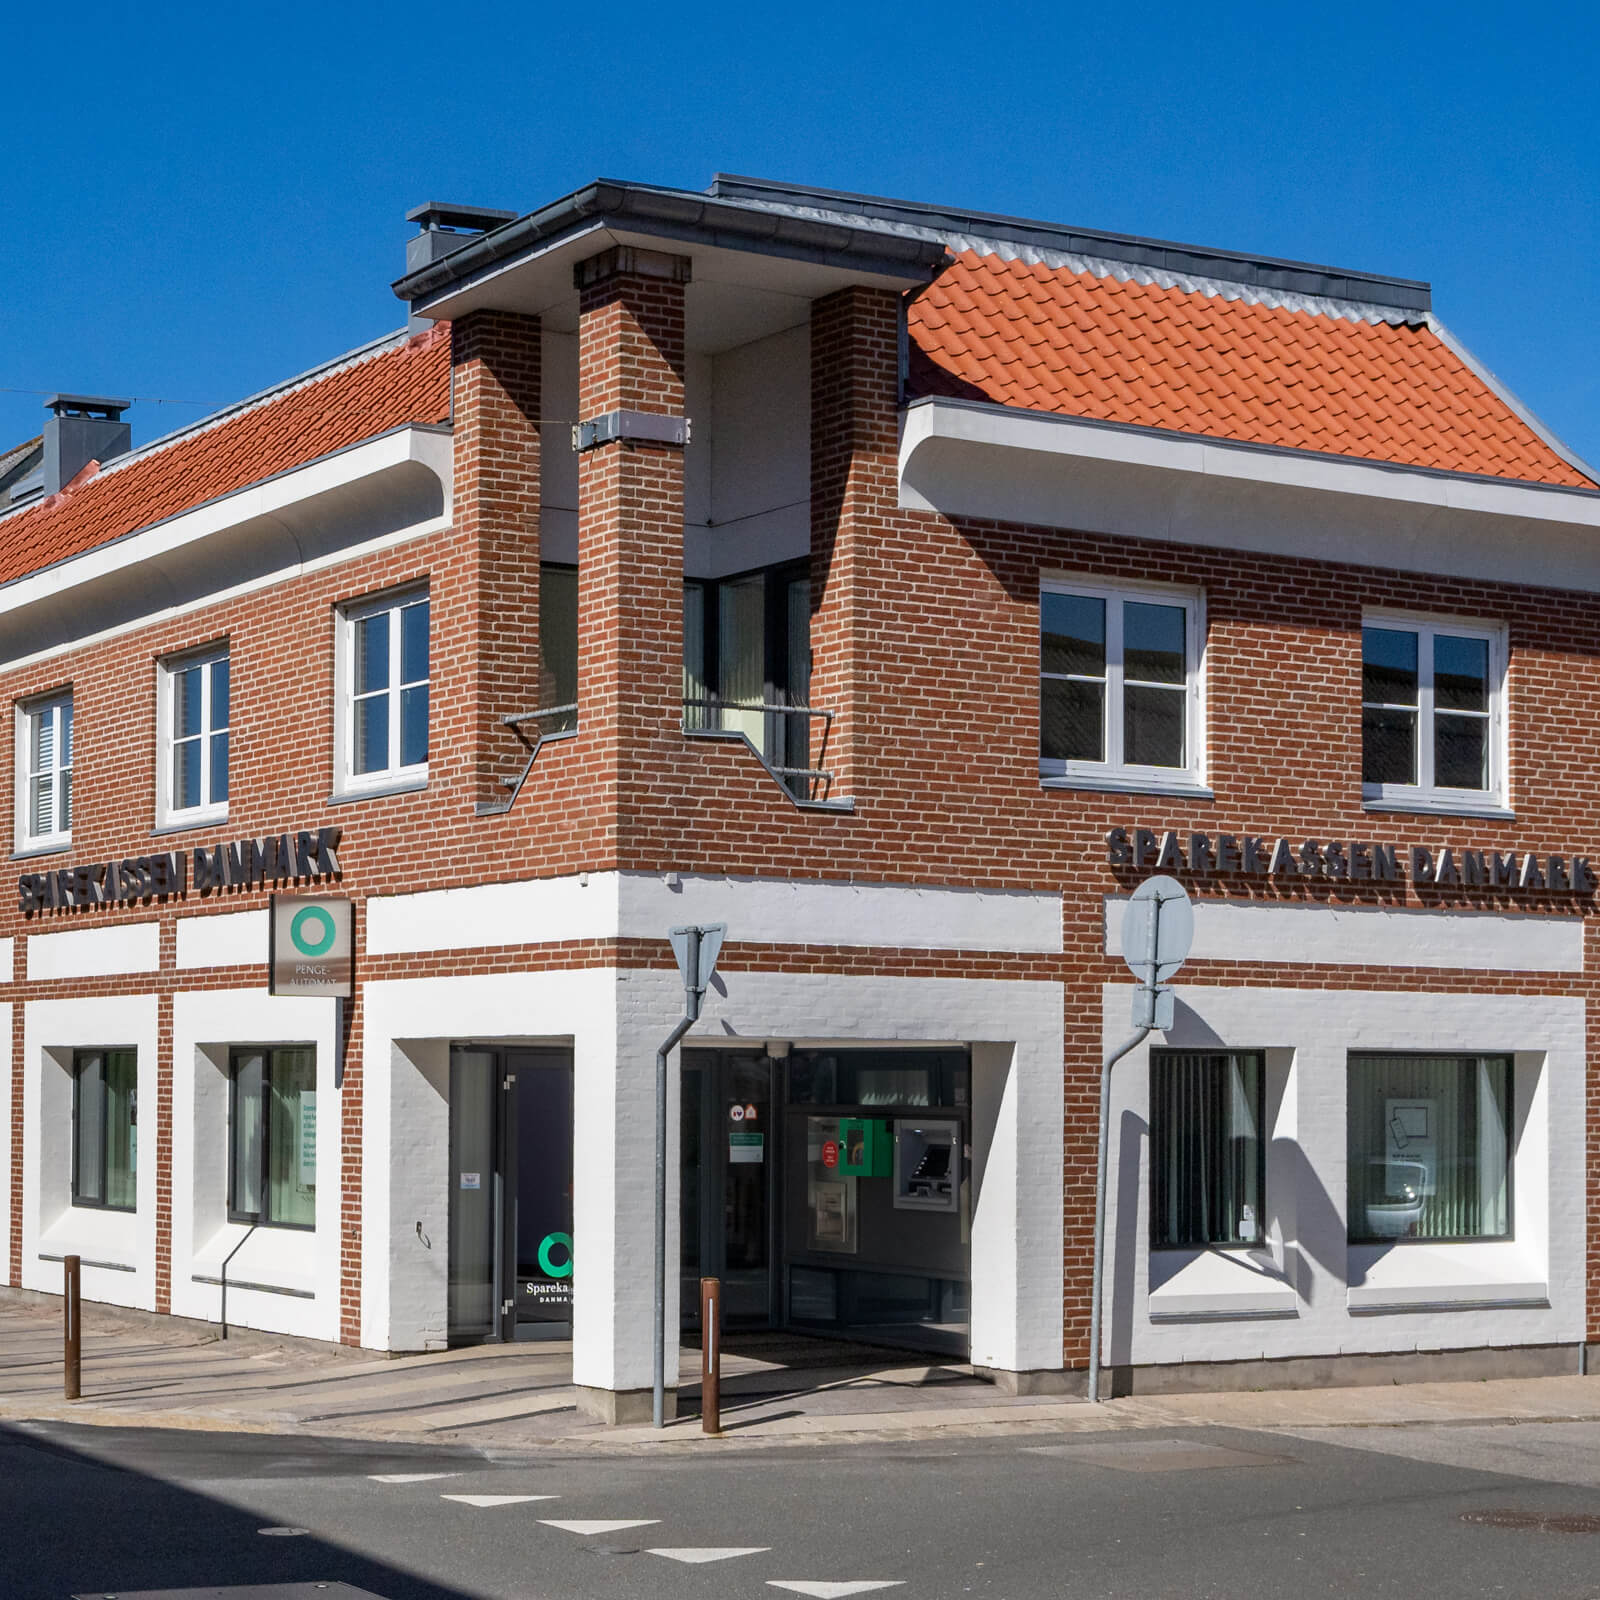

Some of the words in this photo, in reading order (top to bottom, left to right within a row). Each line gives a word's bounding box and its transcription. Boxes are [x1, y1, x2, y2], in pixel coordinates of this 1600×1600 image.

[1105, 827, 1397, 880] SPAREKASSEN
[1408, 846, 1593, 890] DANMARK
[18, 850, 188, 913] SPAREKASSEN
[192, 826, 343, 891] DANMARK
[295, 964, 331, 975] PENGE-
[526, 1281, 573, 1296] Spareka
[539, 1296, 573, 1304] DANMA
